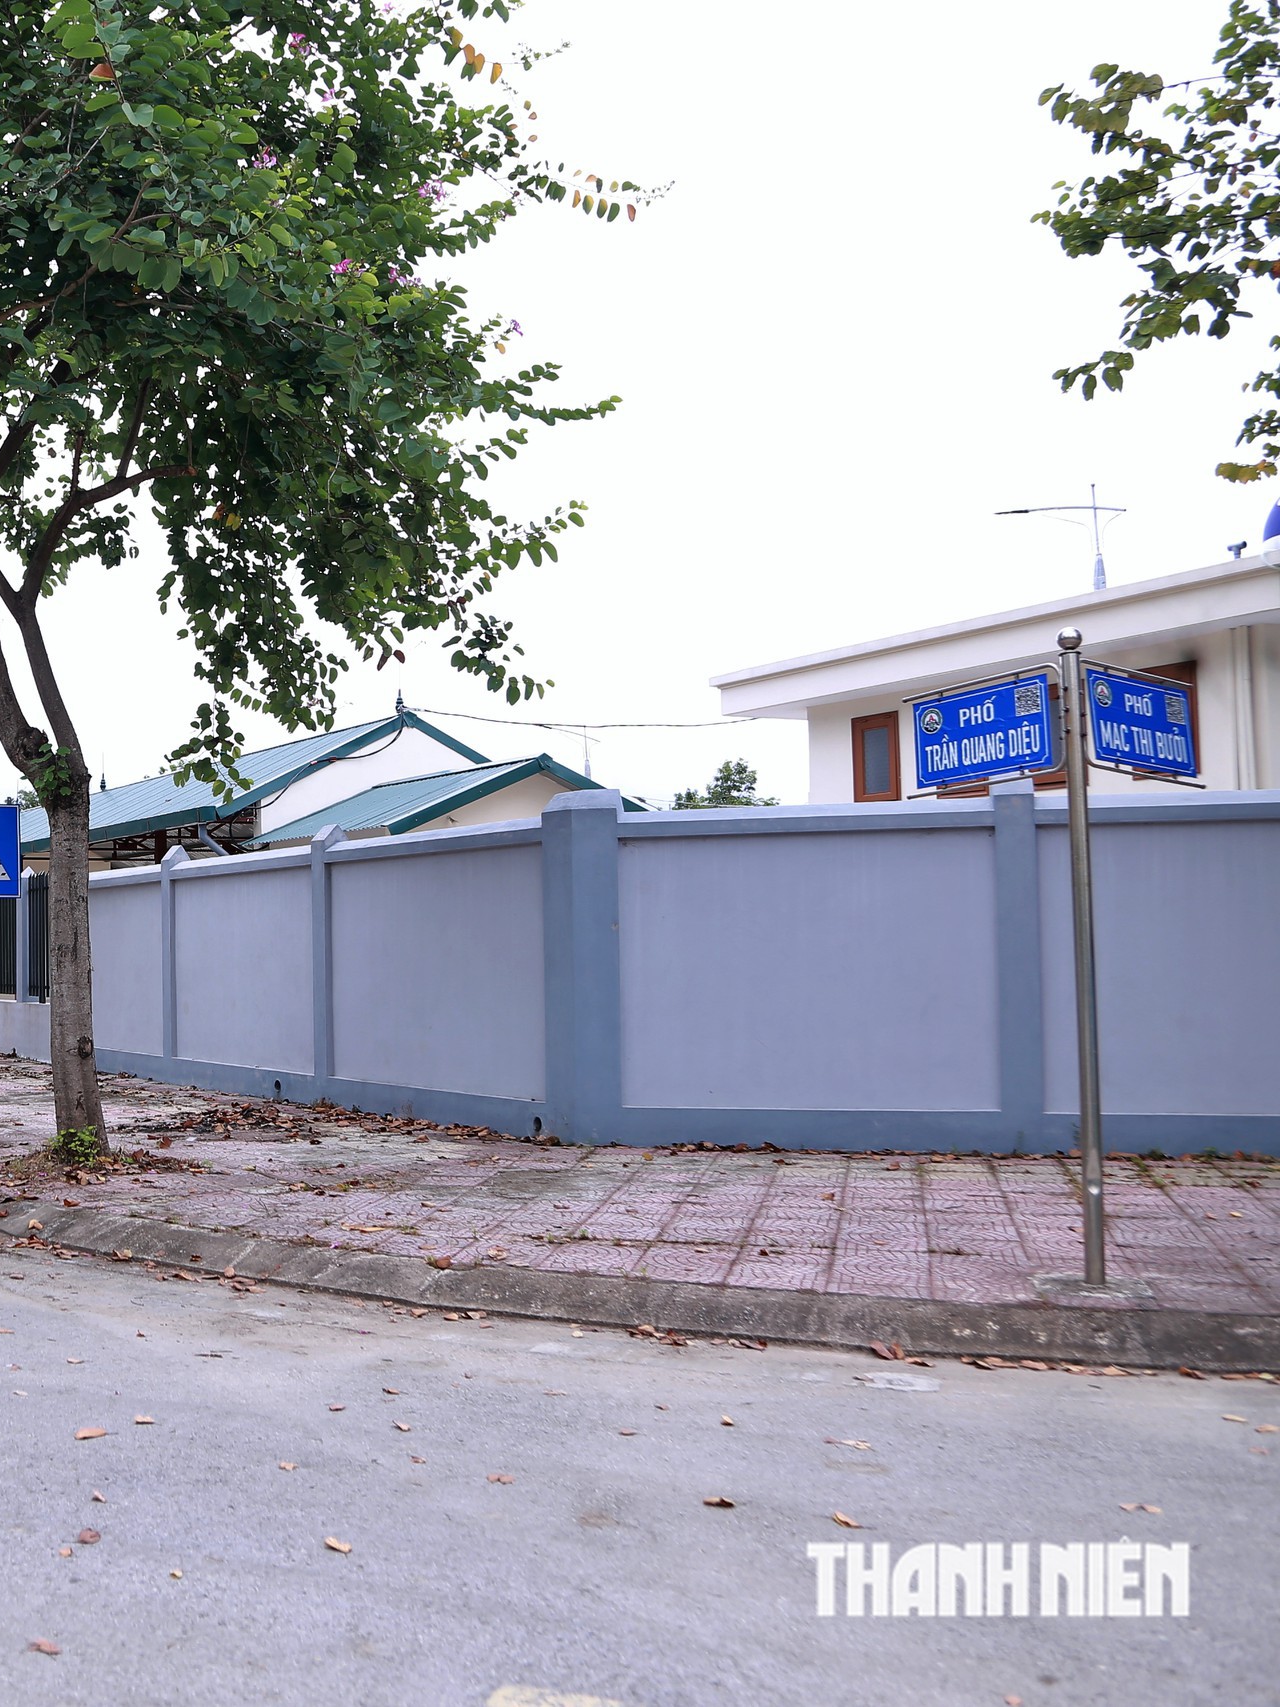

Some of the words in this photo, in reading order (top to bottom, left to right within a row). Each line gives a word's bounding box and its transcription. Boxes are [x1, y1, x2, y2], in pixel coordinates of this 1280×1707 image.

[959, 696, 995, 728] PHỐ
[1124, 692, 1152, 717] PHỐ
[925, 733, 958, 773] TRẦN
[961, 732, 1005, 766] QUANG
[1008, 721, 1040, 761] DIỆU
[1100, 719, 1129, 756] MẠC
[1130, 725, 1155, 763] THỊ
[1156, 726, 1188, 764] BƯỞI
